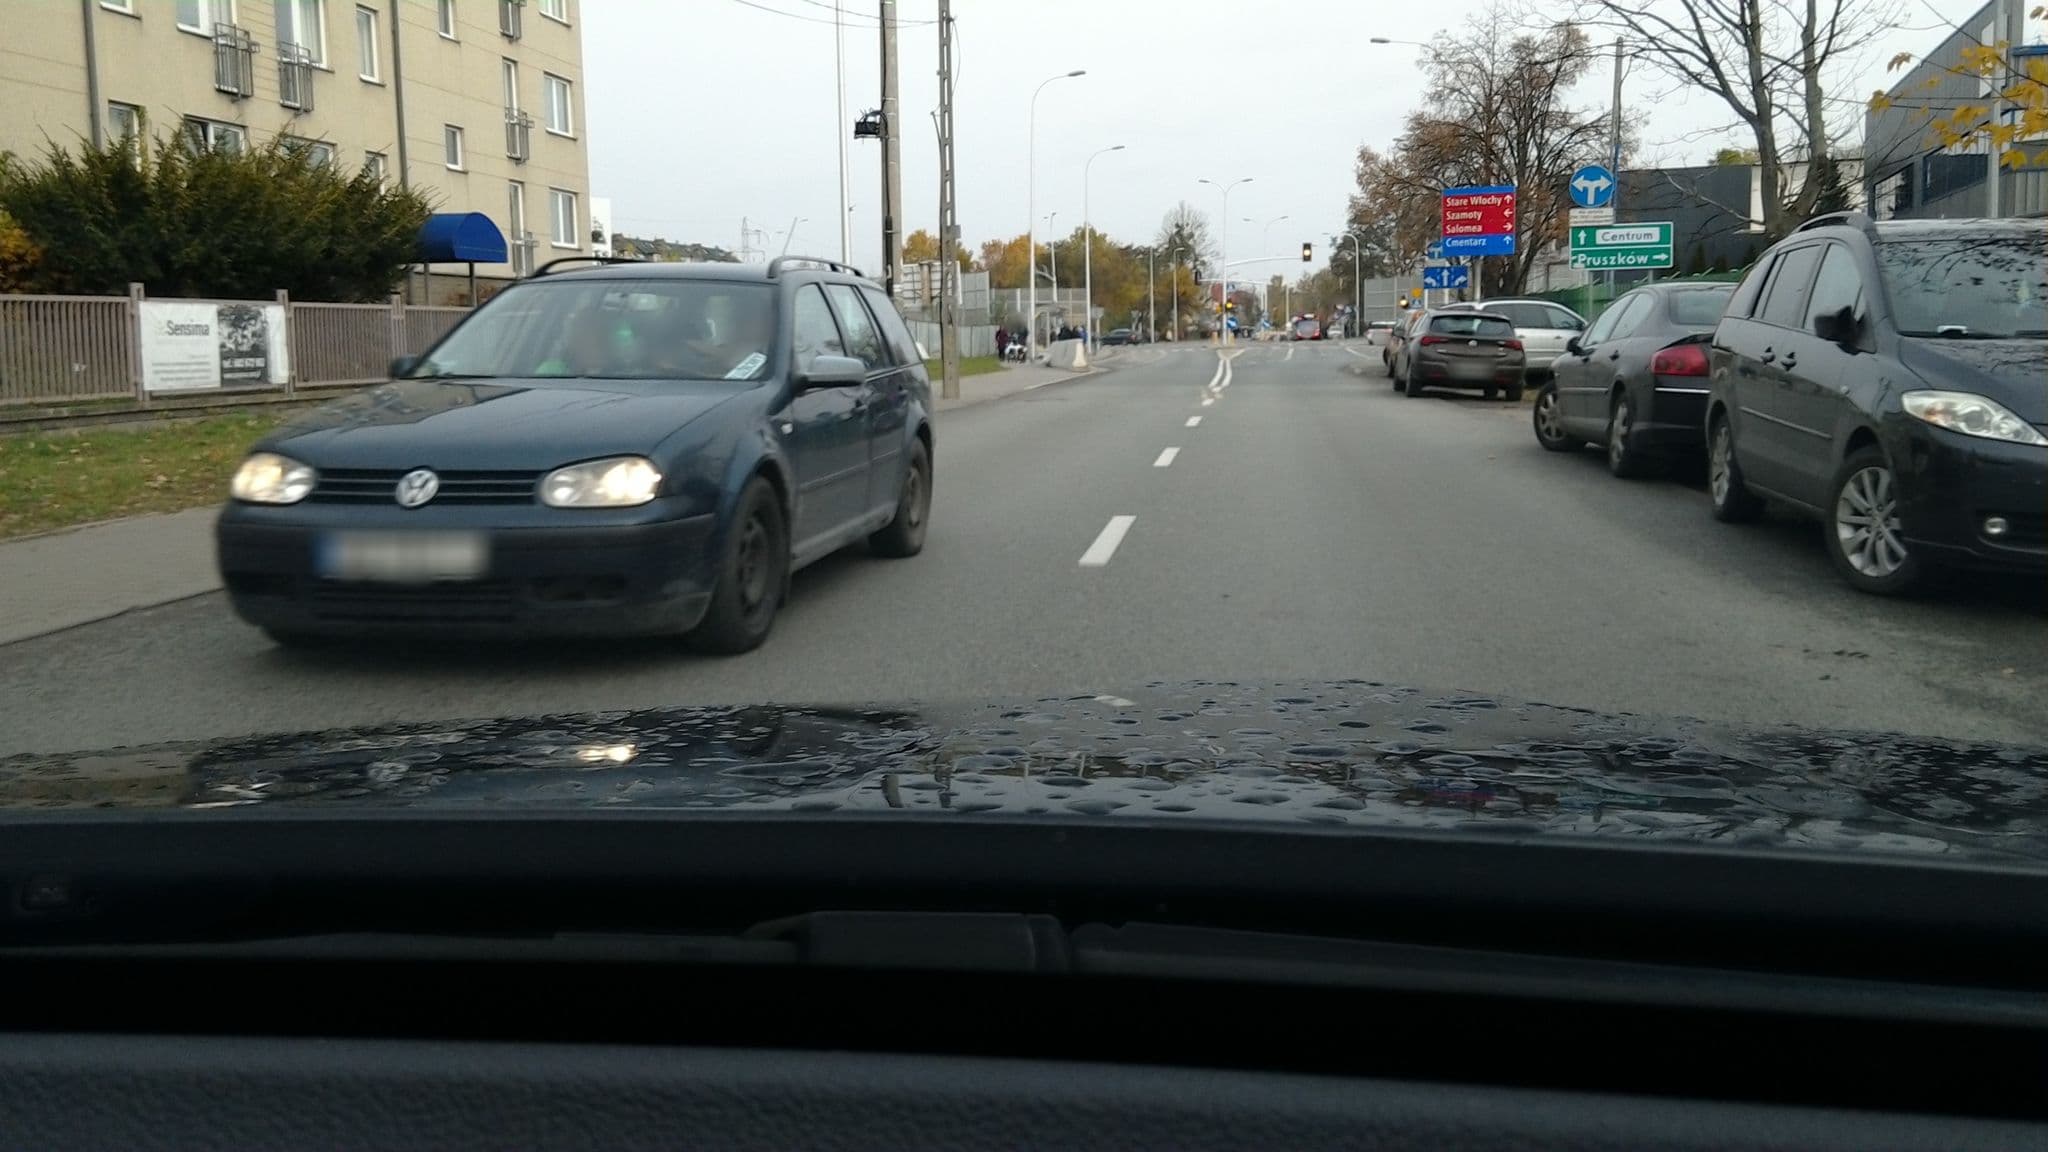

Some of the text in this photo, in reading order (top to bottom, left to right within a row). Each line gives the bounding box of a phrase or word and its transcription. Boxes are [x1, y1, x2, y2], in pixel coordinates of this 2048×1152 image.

[1446, 197, 1468, 207] Stare
[1446, 211, 1482, 221] Szamoty
[1446, 224, 1482, 234] Salomea
[1601, 231, 1653, 242] Centrum
[1445, 237, 1487, 247] Cmentarz
[1578, 251, 1649, 266] Pruszków
[166, 319, 210, 336] Sensima
